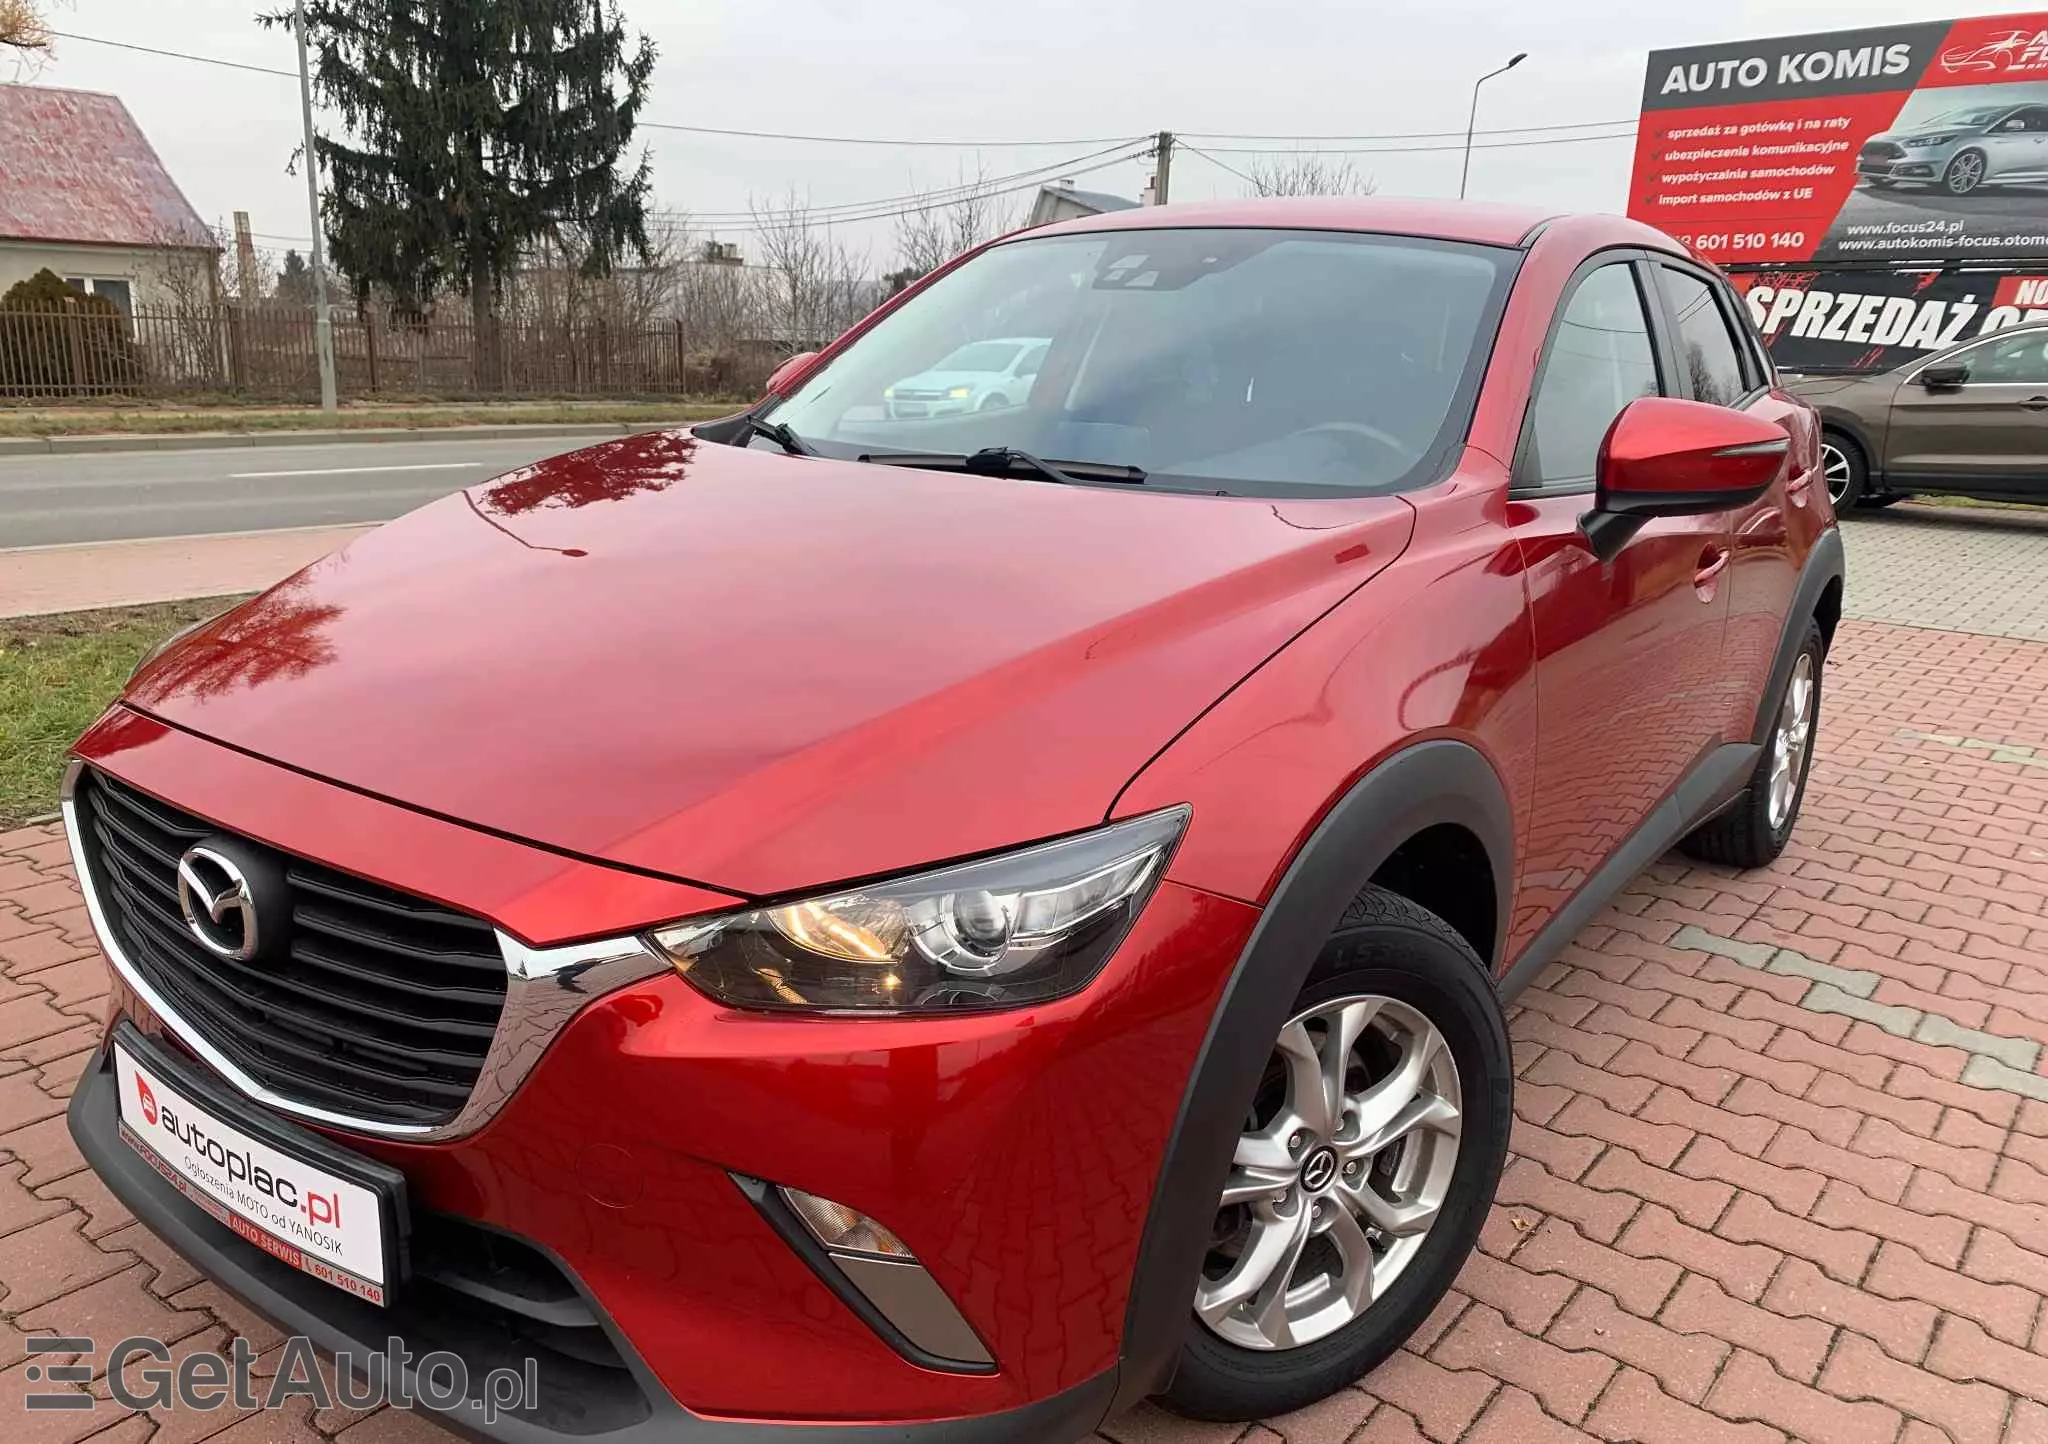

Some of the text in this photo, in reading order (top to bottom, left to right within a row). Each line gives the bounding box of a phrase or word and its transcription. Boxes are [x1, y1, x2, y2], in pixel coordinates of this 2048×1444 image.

[1660, 44, 1912, 95] AUTO KOMIS
[1667, 125, 1721, 140] sprzedaż
[1723, 126, 1738, 136] za
[1740, 119, 1794, 137] gotówkę
[1804, 120, 1821, 129] na
[1824, 117, 1851, 130] raty
[1752, 140, 1849, 156] komunikacyjne
[1661, 164, 1836, 184] wypożyczalnia samochodów
[1659, 187, 1813, 207] import samochodów z UE
[1847, 220, 1964, 235] www.focus24.pl
[1695, 234, 1728, 249] 601
[1733, 233, 1765, 249] 510
[1770, 232, 1804, 249] 140
[1745, 286, 1979, 350] SPRZEDAŻ
[161, 1104, 340, 1228] autoplac.pl
[184, 1156, 235, 1199] Ogłoszenia
[237, 1190, 269, 1219] MOTO
[271, 1214, 286, 1228] od
[290, 1219, 343, 1256] YANOSIK
[232, 1216, 381, 1302] AUTO SERWIS 601 510 140
